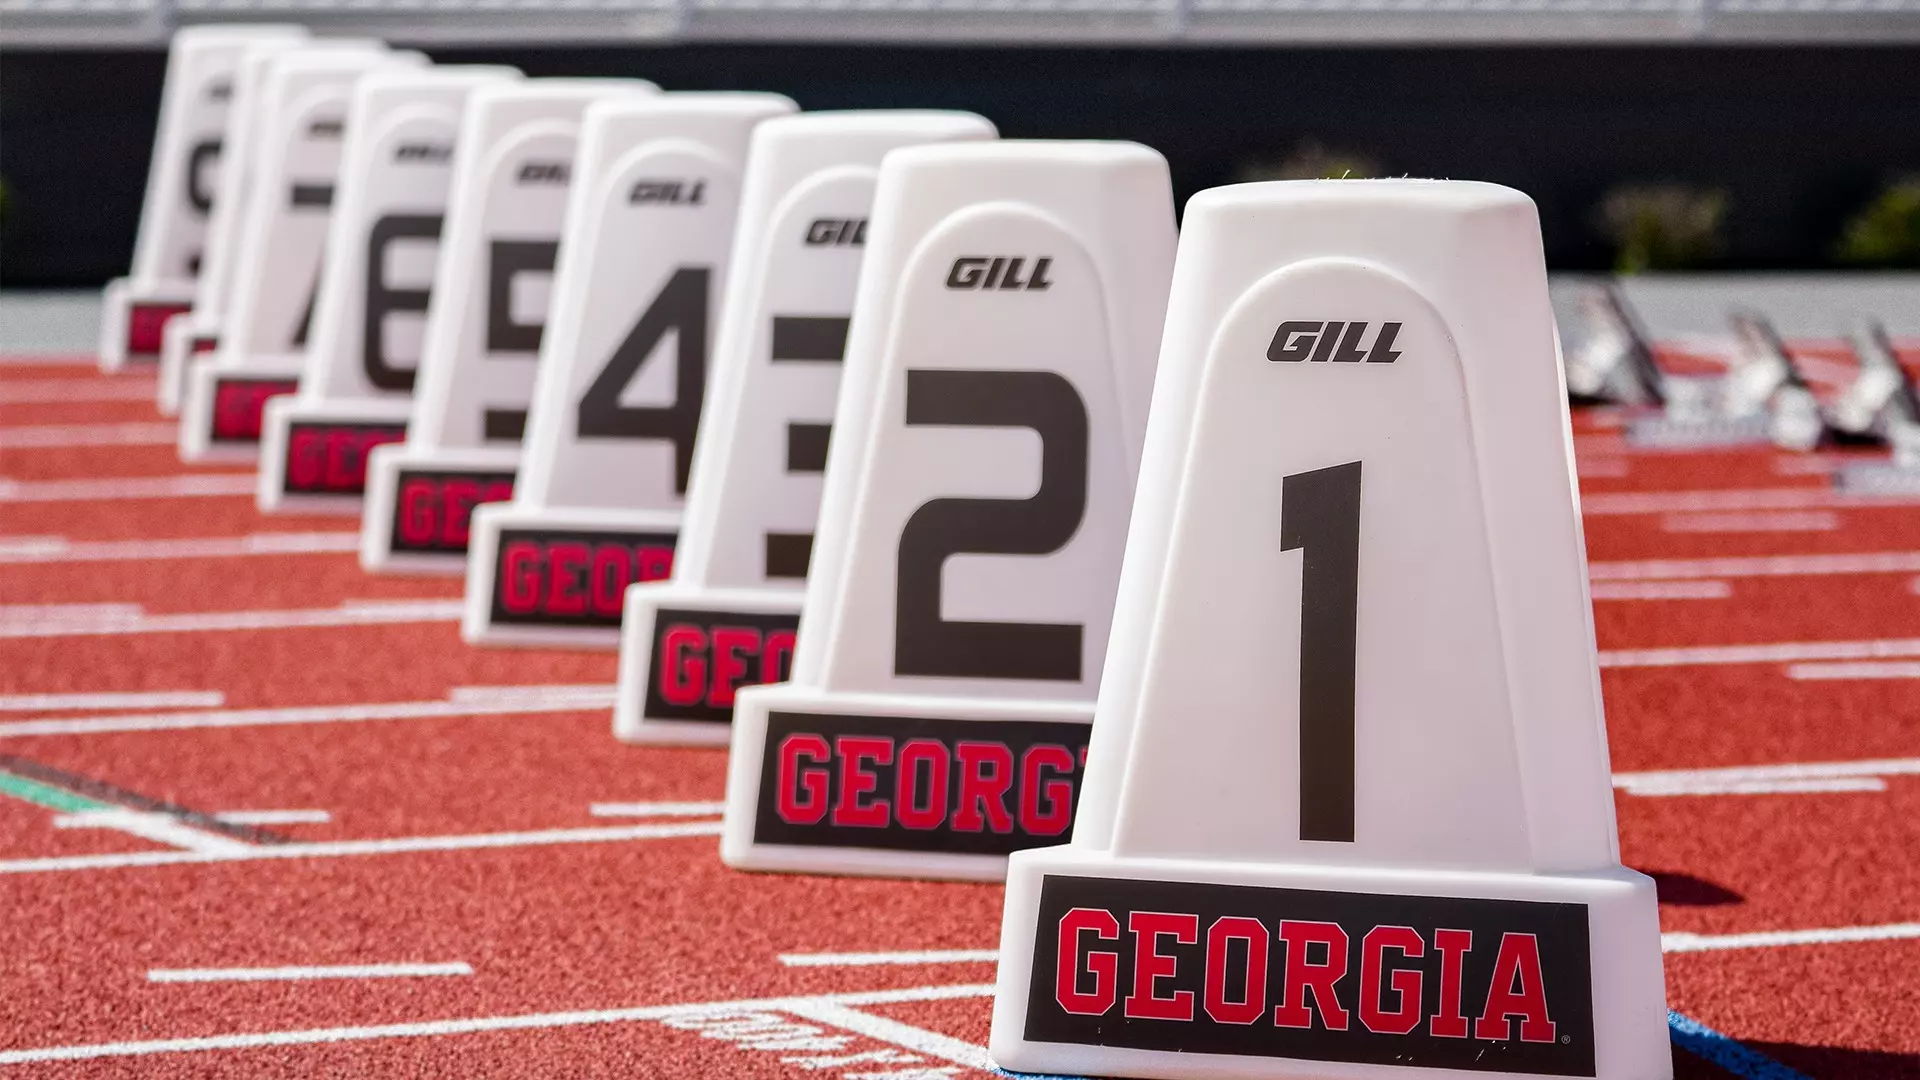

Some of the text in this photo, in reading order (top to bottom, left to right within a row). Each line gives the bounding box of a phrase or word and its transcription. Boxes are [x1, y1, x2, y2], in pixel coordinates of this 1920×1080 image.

[630, 182, 705, 203] GILL
[806, 219, 868, 244] GIL
[945, 257, 1054, 290] GILL
[576, 266, 709, 496] 4
[1266, 320, 1403, 363] GILL
[894, 368, 1089, 682] 2
[1279, 459, 1363, 843] 1
[776, 733, 1088, 836] GEORG
[1054, 907, 1557, 1043] GEORGIA
